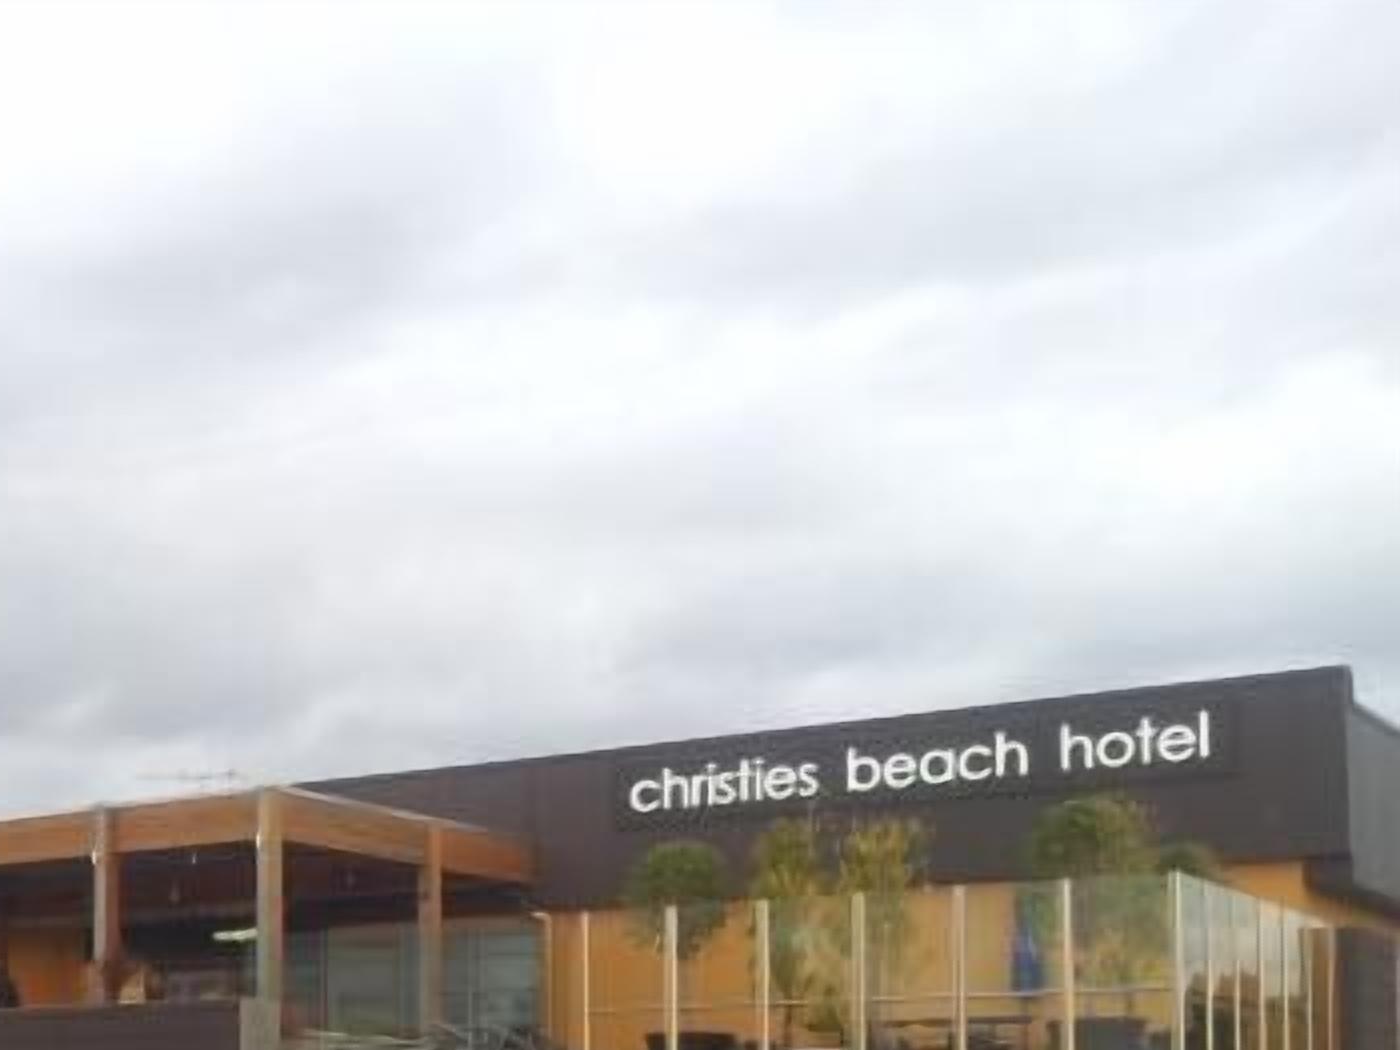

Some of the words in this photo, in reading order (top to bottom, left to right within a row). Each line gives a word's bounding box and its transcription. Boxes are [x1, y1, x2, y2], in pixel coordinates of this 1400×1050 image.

[629, 756, 820, 813] christies
[846, 731, 1029, 792] beach
[1059, 709, 1210, 771] hotel
